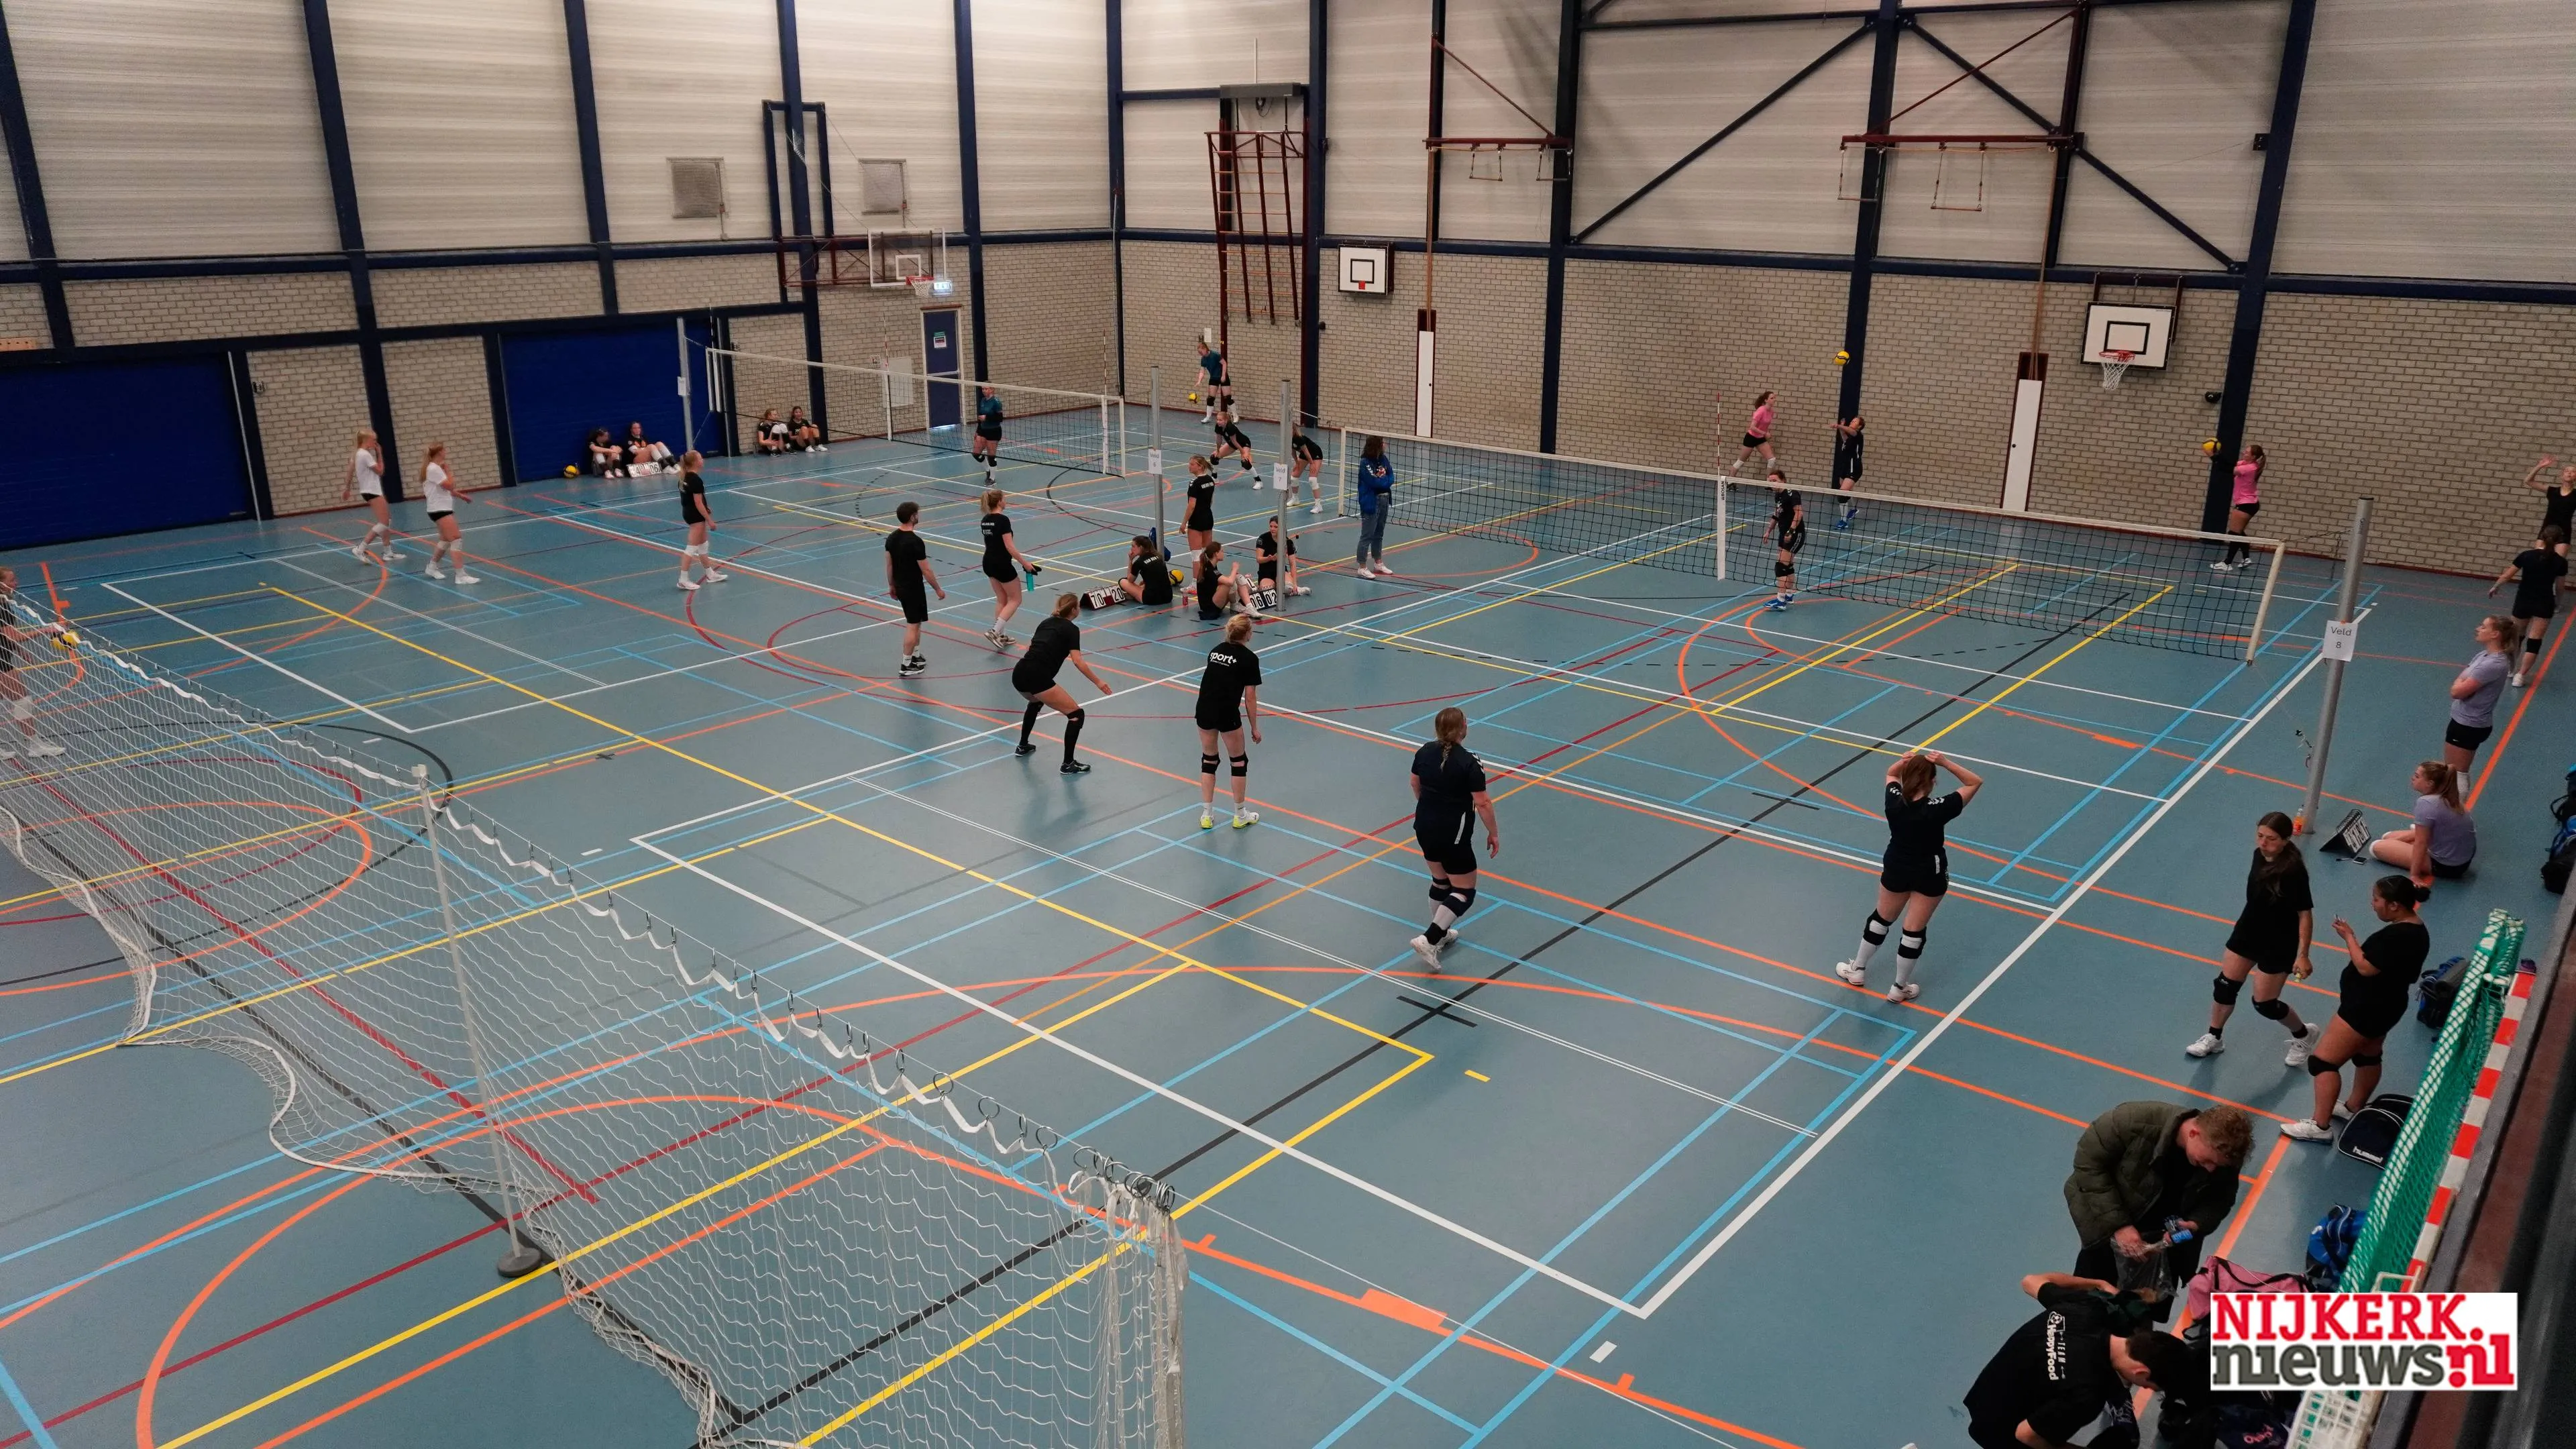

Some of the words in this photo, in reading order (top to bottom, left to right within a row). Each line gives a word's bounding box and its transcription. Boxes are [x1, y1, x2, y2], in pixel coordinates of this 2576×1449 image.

[1091, 593, 1104, 607] 70
[1112, 588, 1124, 602] 20
[1265, 592, 1277, 605] 02
[2330, 626, 2352, 636] Veld
[2057, 1342, 2066, 1362] TEAM
